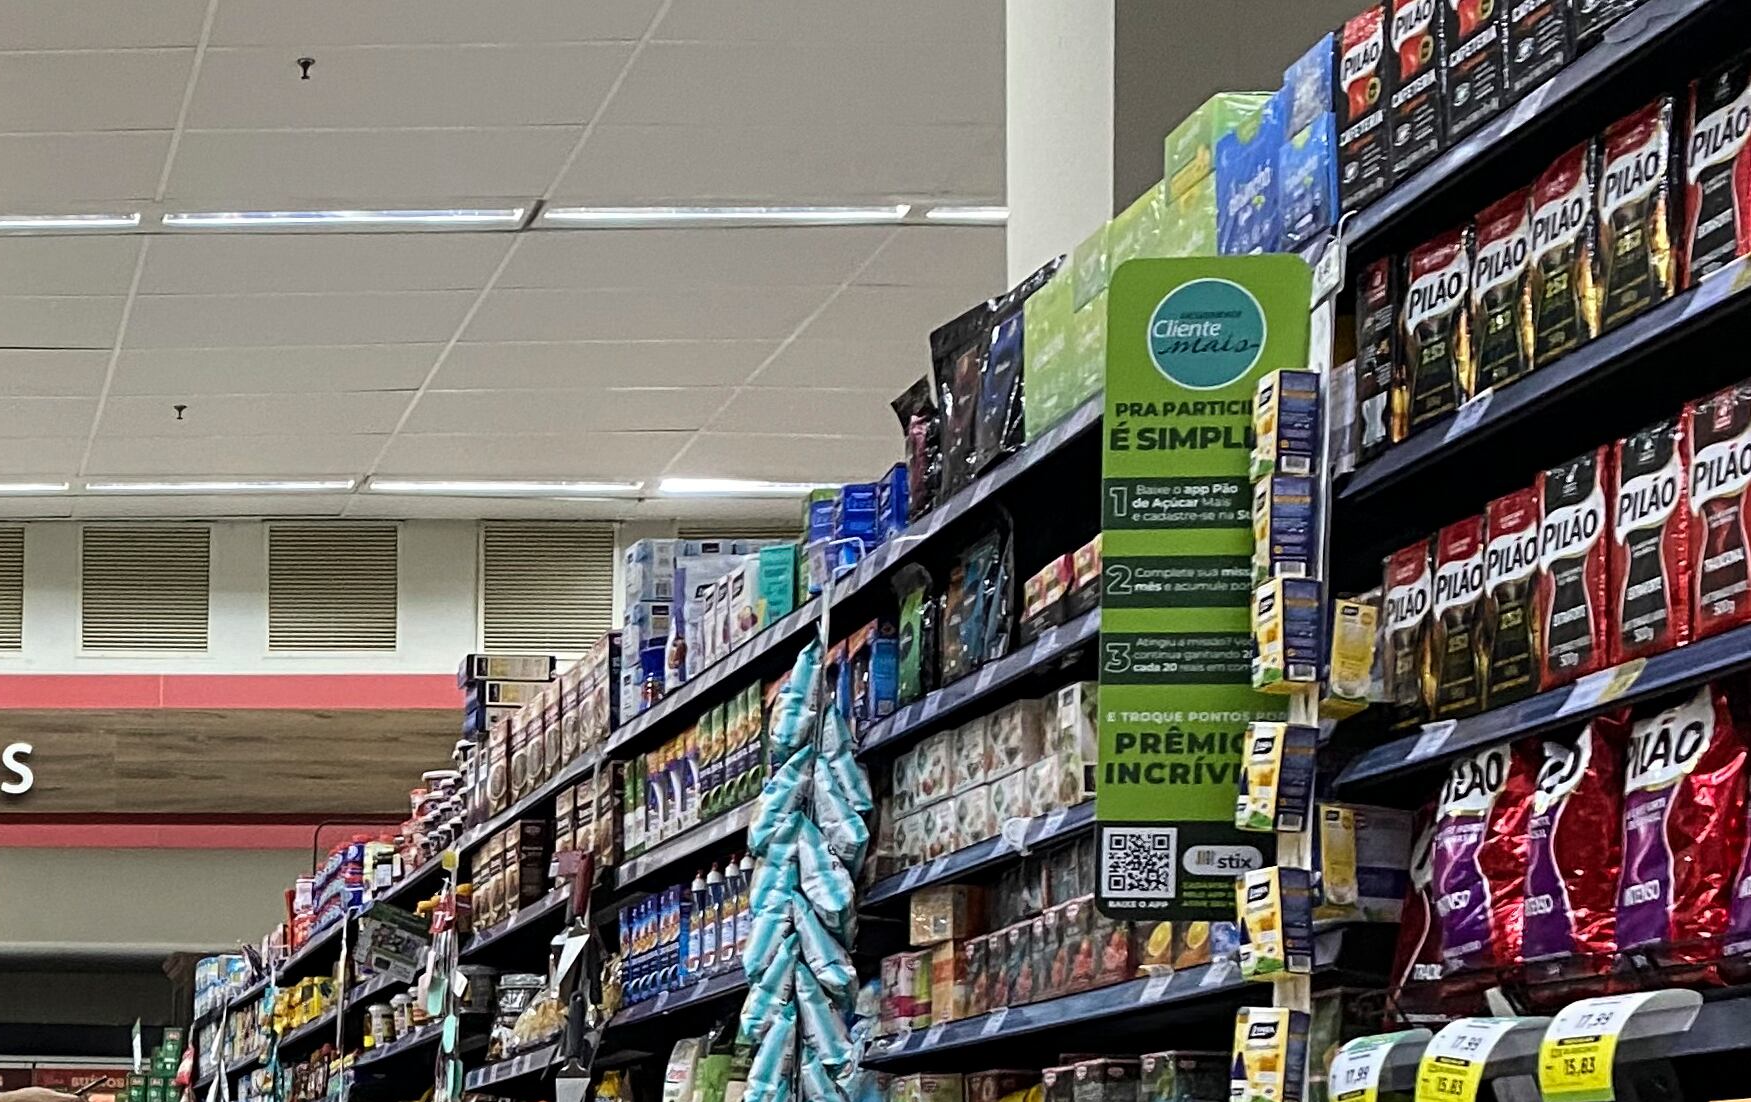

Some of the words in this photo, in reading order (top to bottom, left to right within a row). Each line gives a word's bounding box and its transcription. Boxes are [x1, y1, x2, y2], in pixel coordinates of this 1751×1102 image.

[1603, 148, 1658, 207] PILÃO
[1532, 195, 1583, 252] PILÃO
[1476, 235, 1527, 290] PILÃO
[1408, 269, 1463, 322] PILÃO
[1152, 319, 1222, 338] Cliente
[1115, 402, 1159, 417] PRA
[1110, 422, 1130, 451] É
[1109, 487, 1129, 517] 1
[1132, 499, 1149, 509] de
[1151, 497, 1199, 512] Açúcar
[1183, 484, 1210, 496] app
[1212, 483, 1239, 494] Pão
[1619, 471, 1675, 528] PILÃO
[1542, 504, 1596, 565] PILÃO
[1106, 564, 1132, 595] 2
[1105, 643, 1132, 674] 3
[1133, 663, 1161, 673] cada
[1162, 663, 1178, 672] 20
[1122, 711, 1183, 723] TROQUE
[1188, 711, 1250, 722] PONTOS
[1217, 853, 1253, 870] stix
